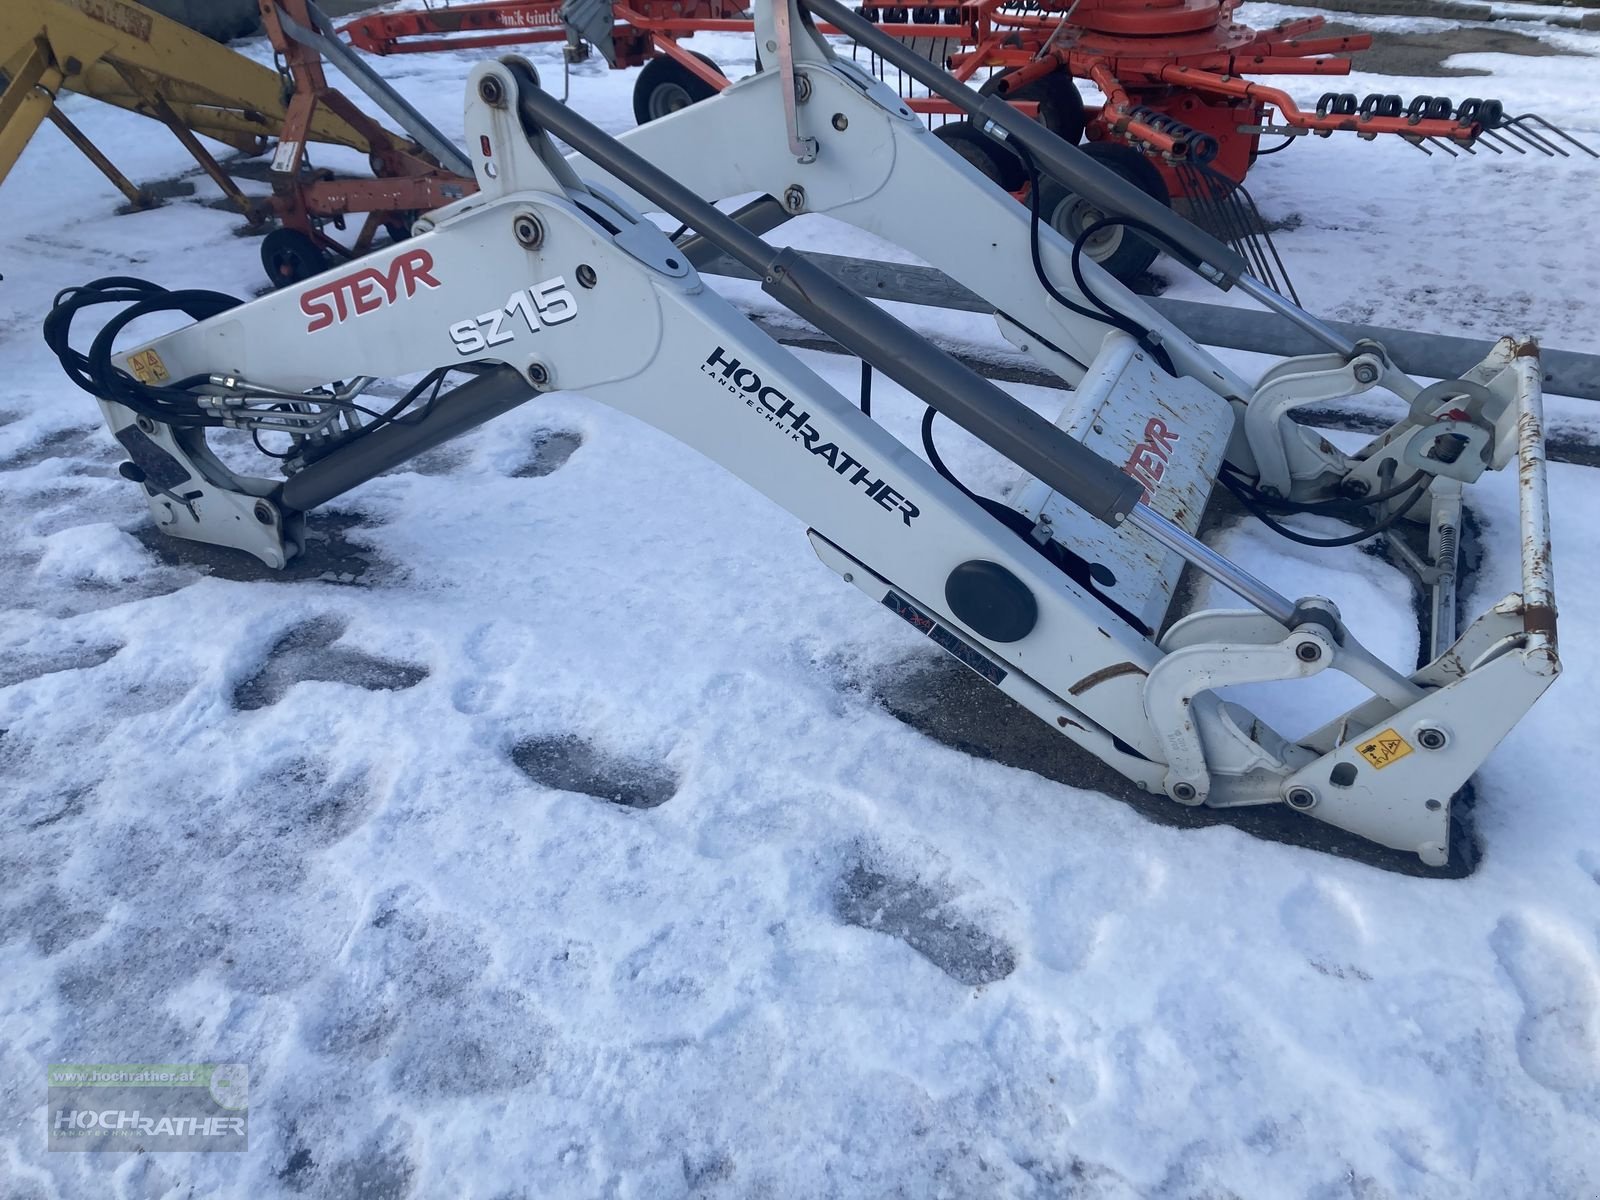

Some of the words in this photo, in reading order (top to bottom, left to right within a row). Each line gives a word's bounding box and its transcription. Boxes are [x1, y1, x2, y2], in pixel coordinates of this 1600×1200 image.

[300, 249, 441, 333] STEYR
[700, 364, 800, 442] LANDTECHNIK
[706, 346, 920, 528] HOCHRATHER
[1123, 417, 1181, 506] TEYR
